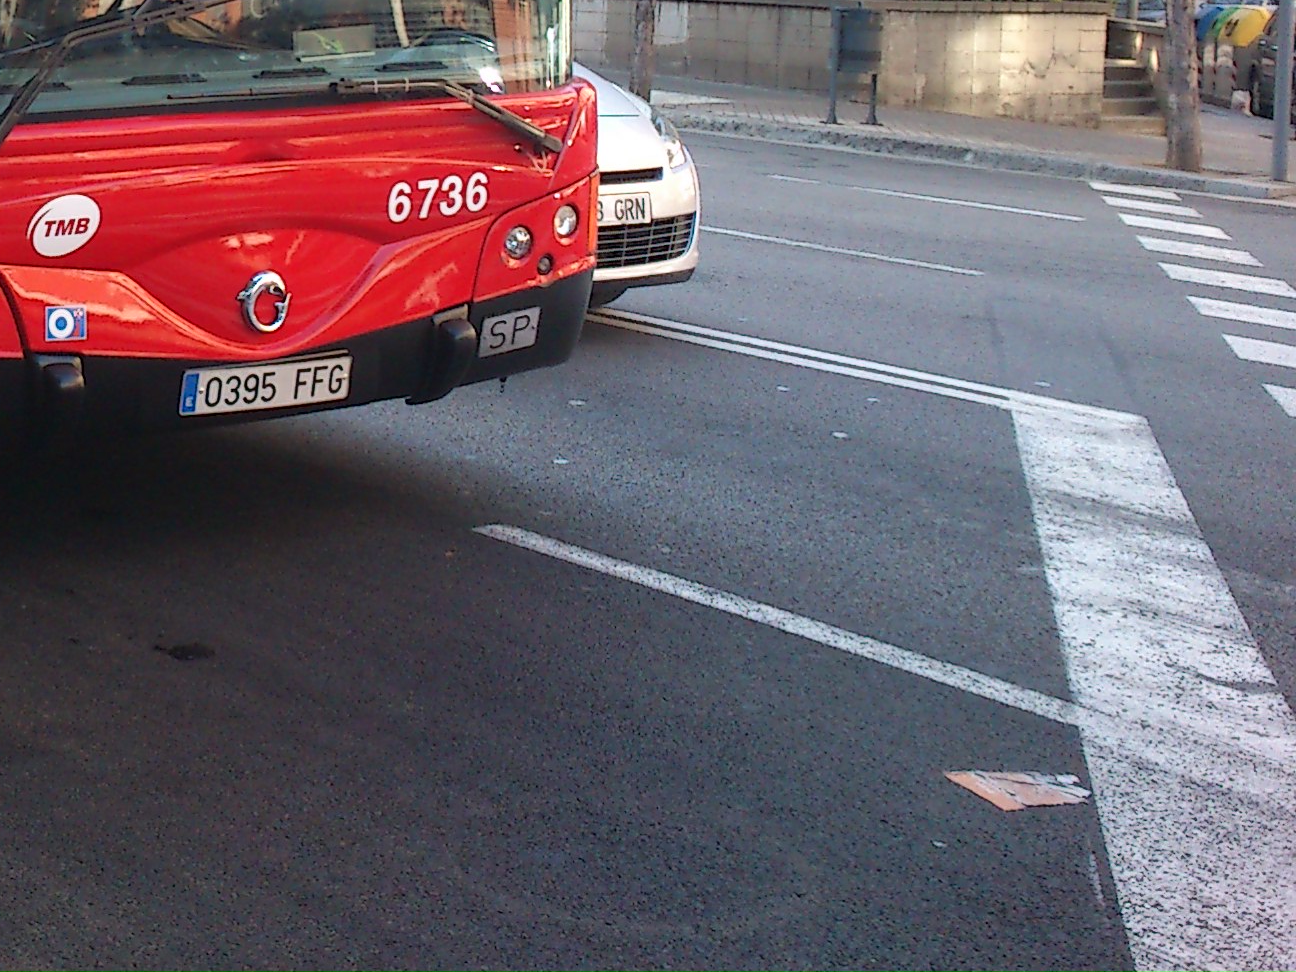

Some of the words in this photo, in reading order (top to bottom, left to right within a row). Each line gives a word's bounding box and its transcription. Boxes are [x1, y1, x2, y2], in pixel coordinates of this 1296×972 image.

[387, 171, 489, 224] 6736
[614, 197, 646, 221] GRN
[44, 217, 90, 238] TMB
[489, 314, 531, 350] SP
[204, 371, 277, 408] 0395
[293, 364, 345, 400] FFG
